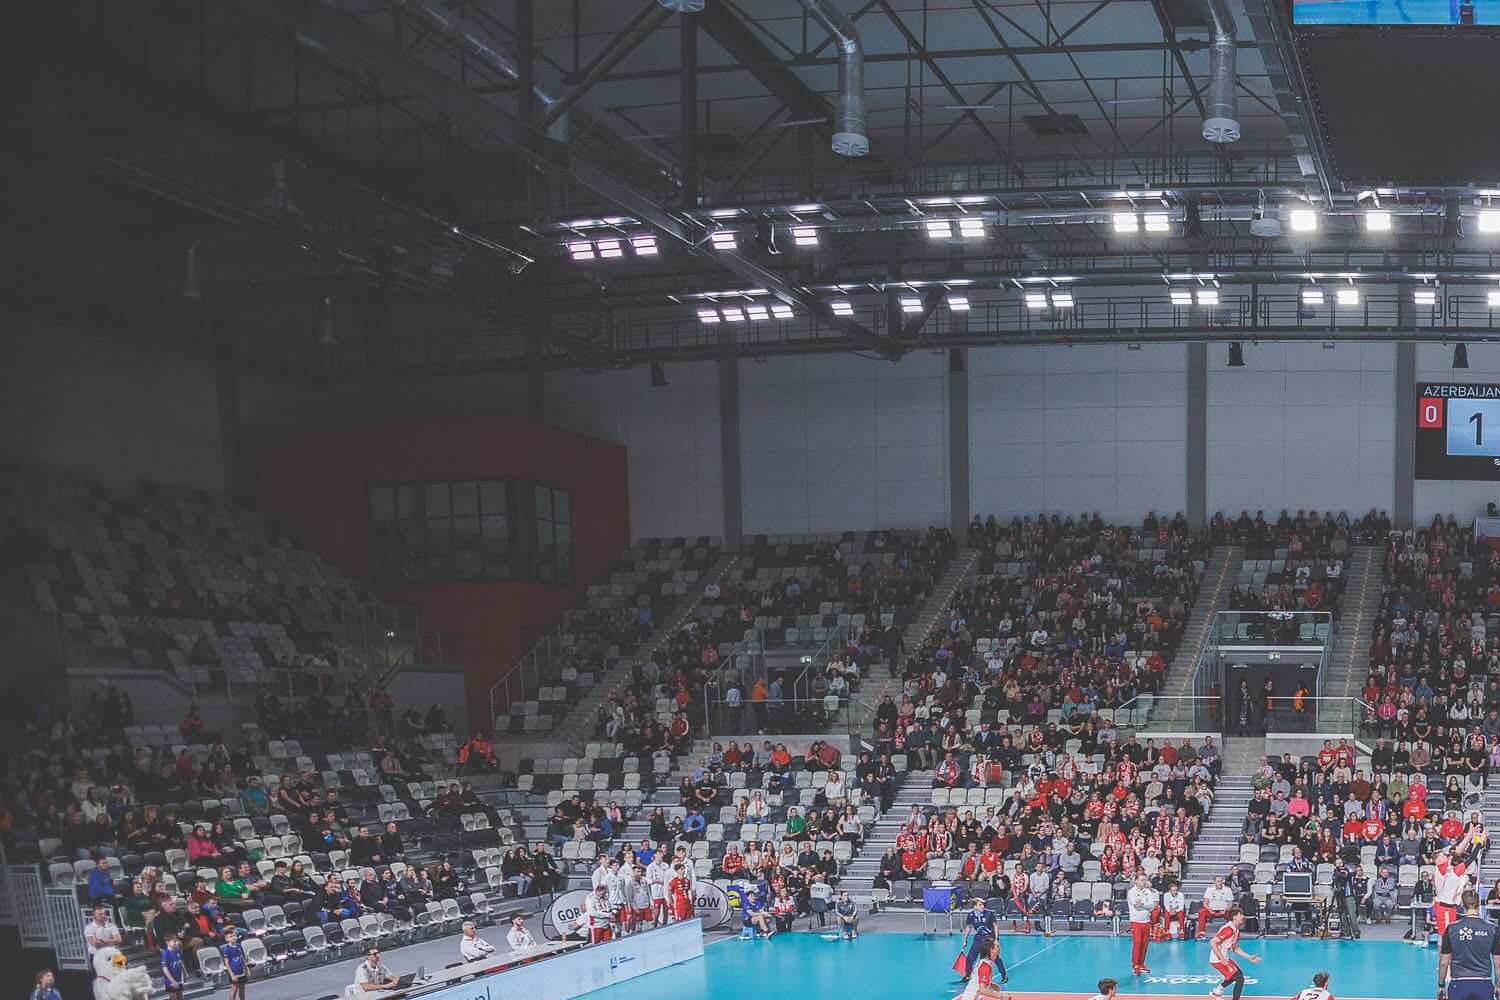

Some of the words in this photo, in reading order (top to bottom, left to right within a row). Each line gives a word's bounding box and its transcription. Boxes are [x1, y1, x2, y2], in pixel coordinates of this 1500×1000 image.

[1425, 405, 1438, 423] 0
[1469, 412, 1483, 446] 1
[558, 907, 581, 921] GOR
